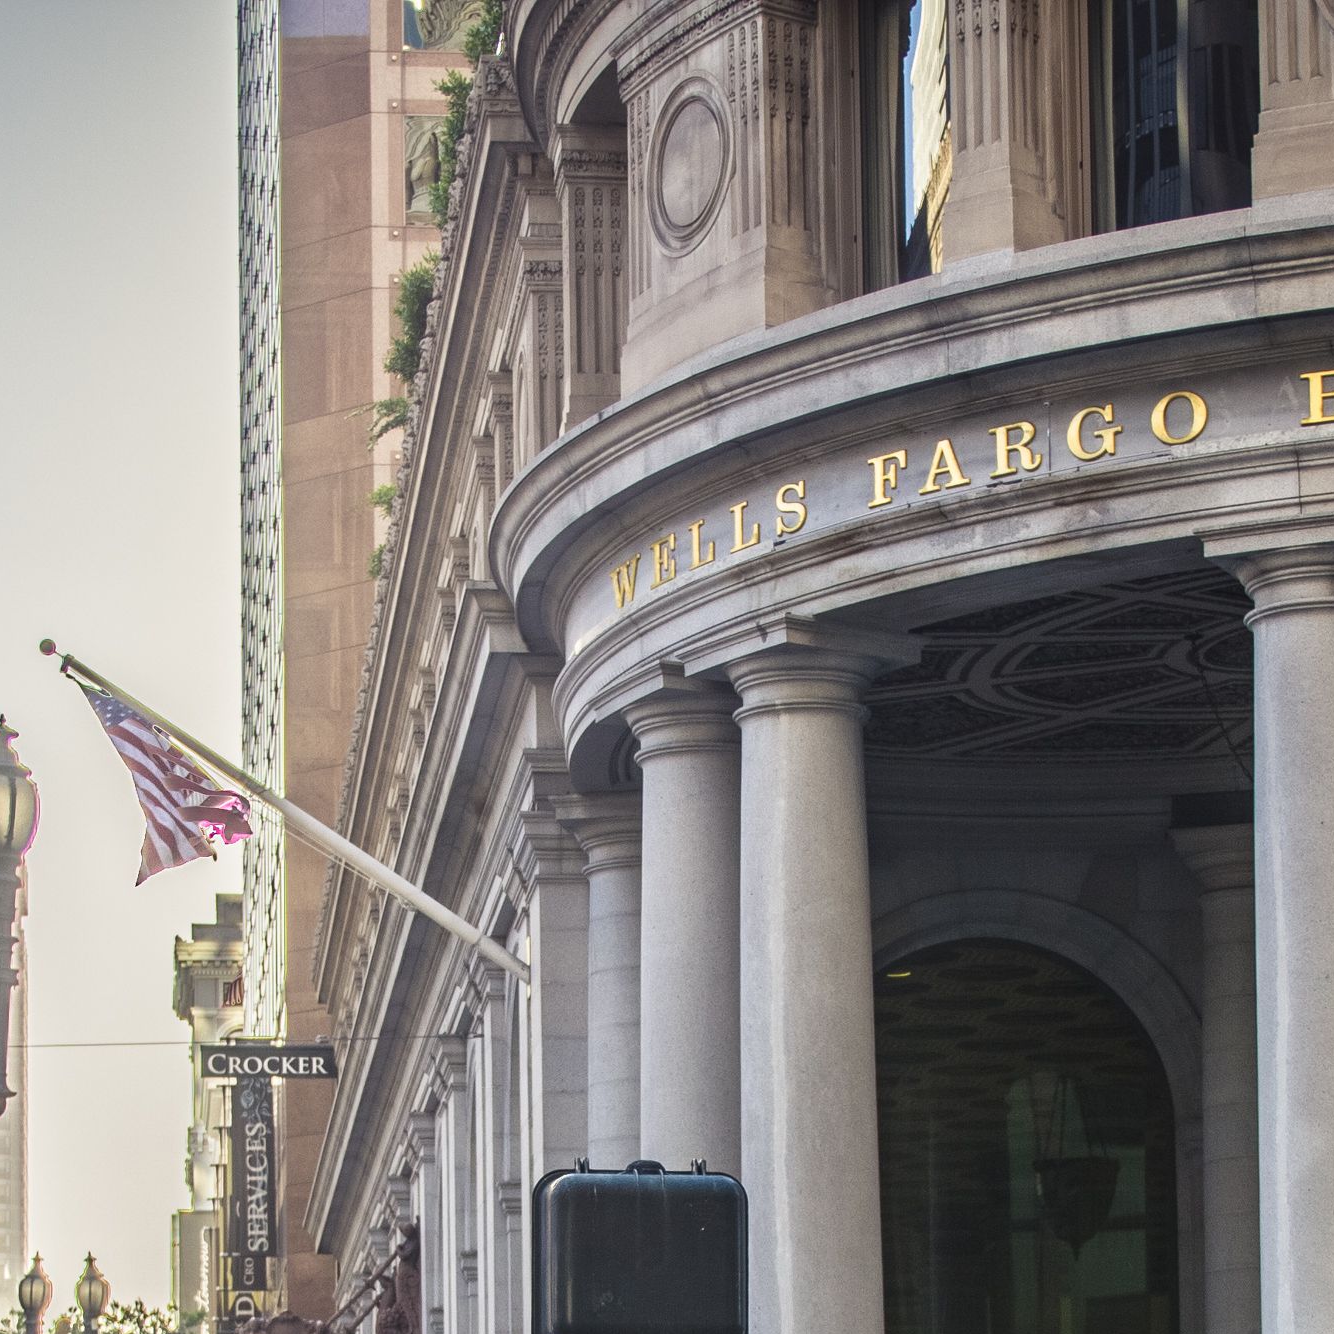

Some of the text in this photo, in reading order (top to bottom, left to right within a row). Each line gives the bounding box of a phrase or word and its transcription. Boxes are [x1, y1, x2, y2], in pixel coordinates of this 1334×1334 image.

[610, 479, 807, 609] WELLS
[867, 390, 1208, 508] FARGO
[207, 1053, 328, 1075] CROCKER
[245, 1122, 269, 1252] SERVICES
